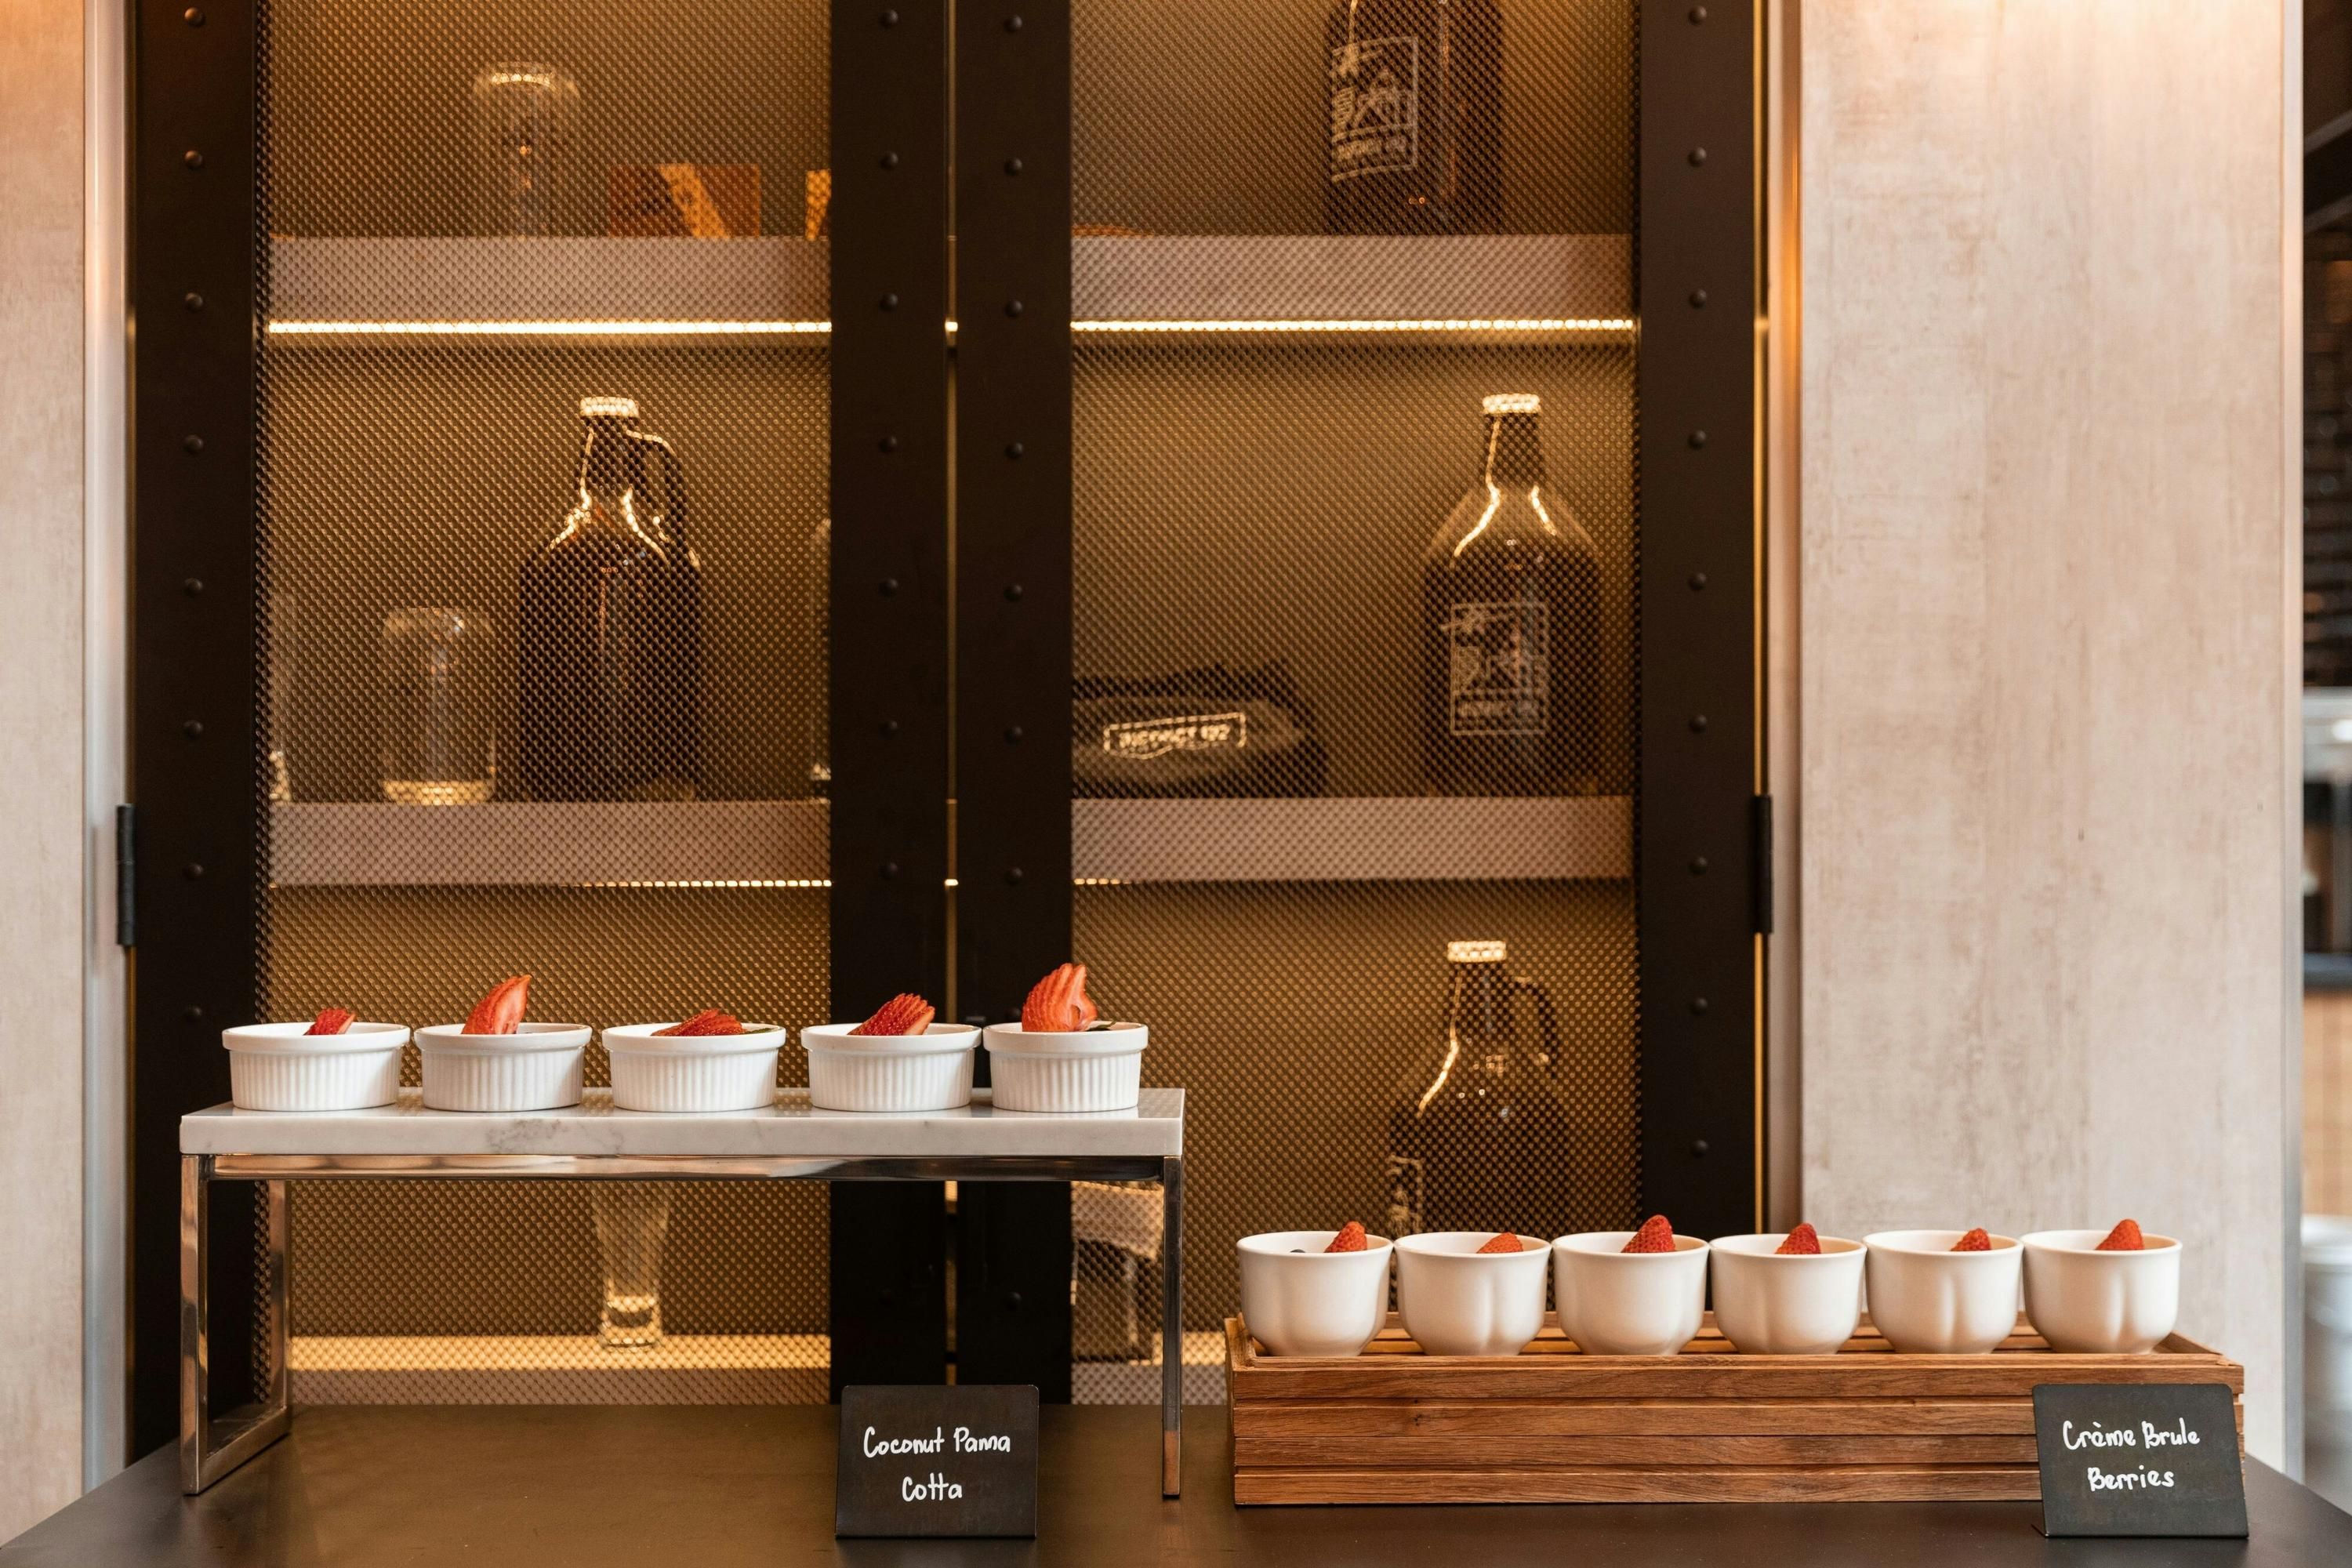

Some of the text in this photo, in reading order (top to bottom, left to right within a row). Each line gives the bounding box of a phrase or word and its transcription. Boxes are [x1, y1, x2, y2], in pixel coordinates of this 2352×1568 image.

[863, 1426, 945, 1458] Coconut
[2062, 1417, 2201, 1450] Crème Brule
[902, 1472, 963, 1502] Cotta
[2087, 1465, 2175, 1492] Berries
